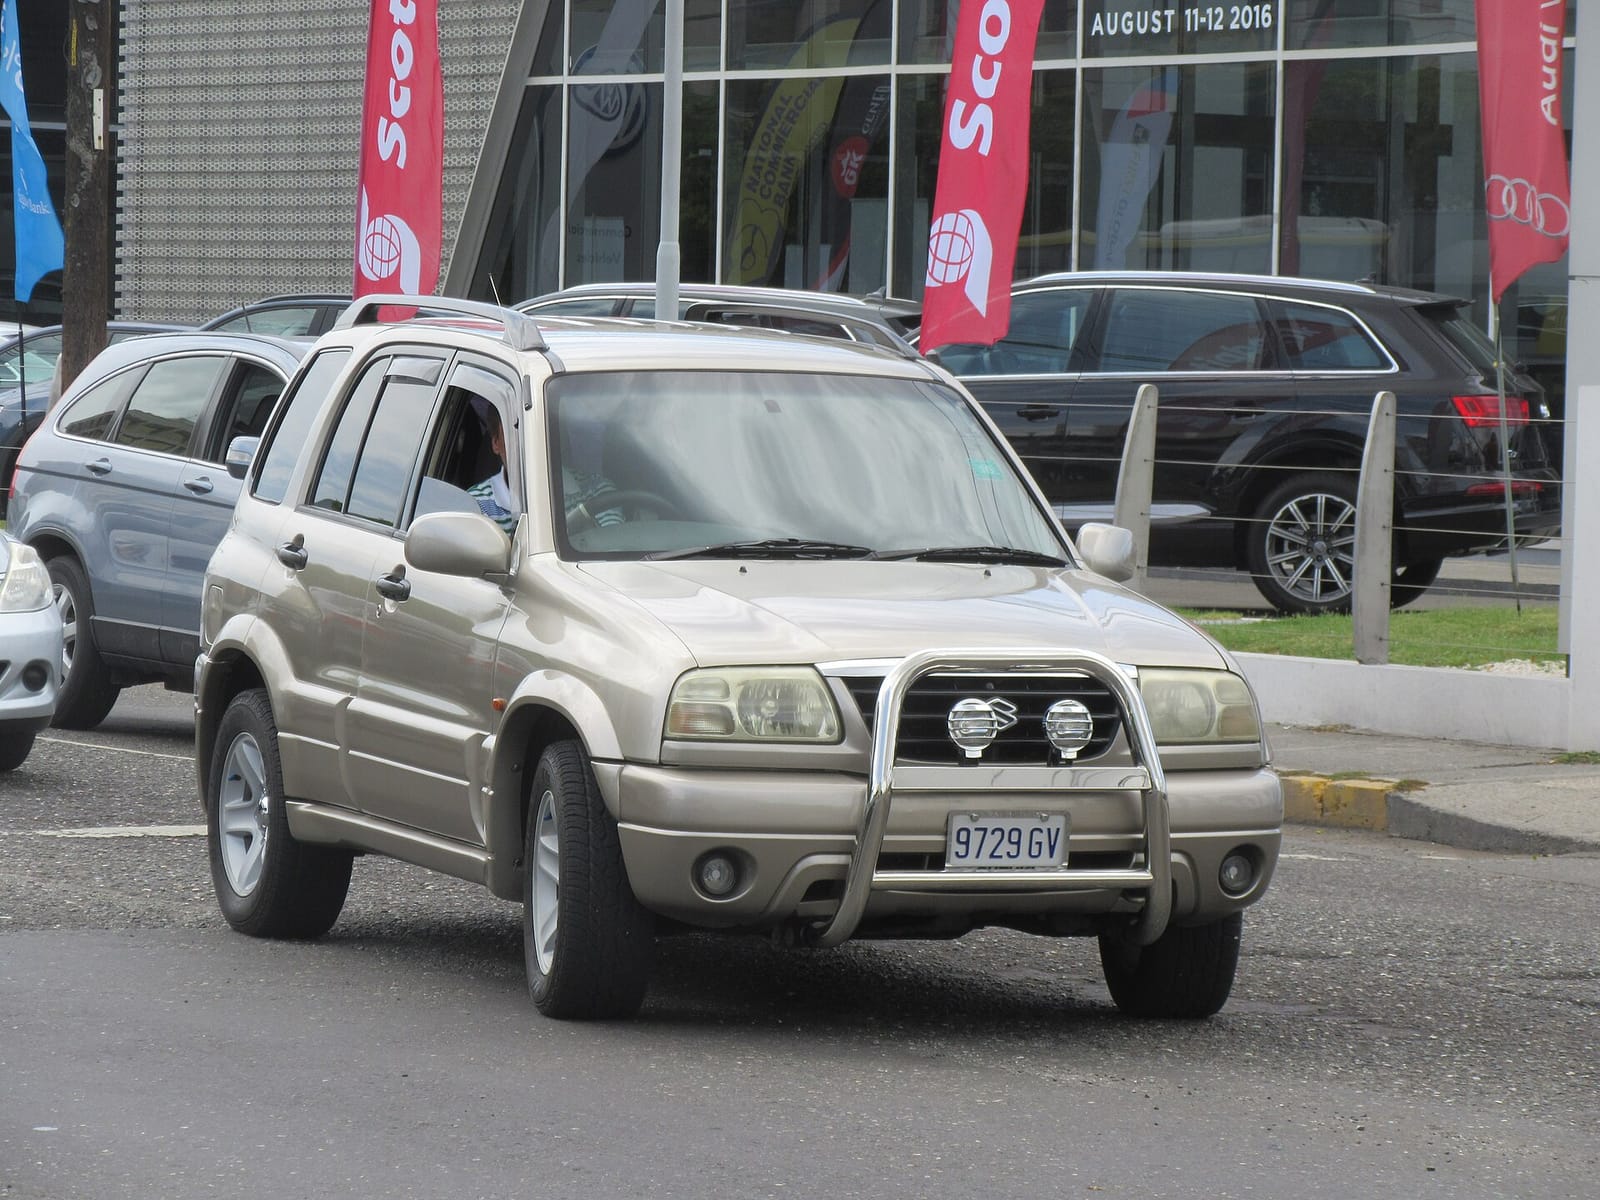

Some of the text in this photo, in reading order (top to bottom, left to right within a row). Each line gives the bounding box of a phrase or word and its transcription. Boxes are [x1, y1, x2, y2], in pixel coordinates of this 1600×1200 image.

[1091, 4, 1273, 35] AUGUST 11-12 2016
[1538, 21, 1560, 126] Audi
[747, 94, 792, 193] NATIONAL
[760, 78, 824, 200] COMMERCIA
[774, 154, 796, 209] BANK
[955, 827, 1061, 859] 9729 GV
